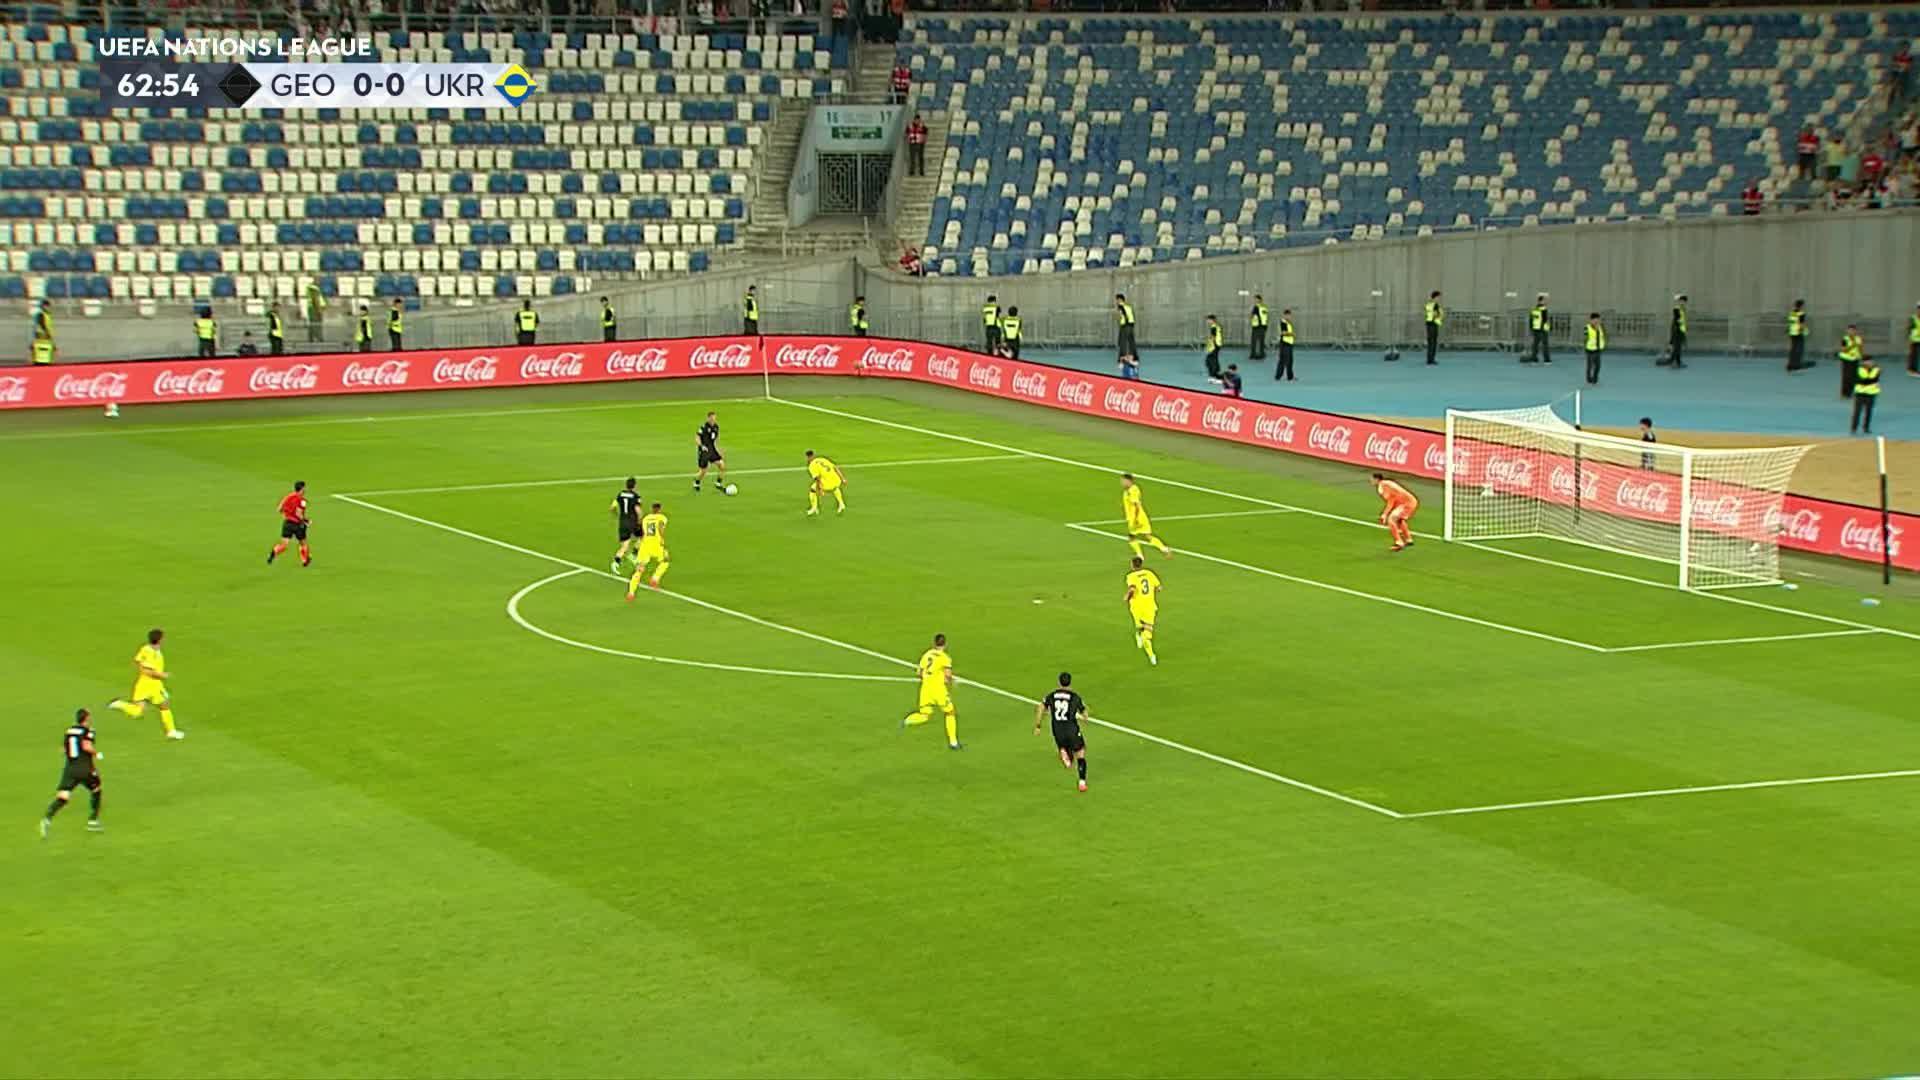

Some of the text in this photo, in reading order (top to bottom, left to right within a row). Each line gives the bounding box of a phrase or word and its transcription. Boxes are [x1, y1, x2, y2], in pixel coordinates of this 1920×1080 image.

[1140, 578, 1150, 595] 3
[926, 656, 935, 675] 2
[1054, 699, 1069, 721] 22
